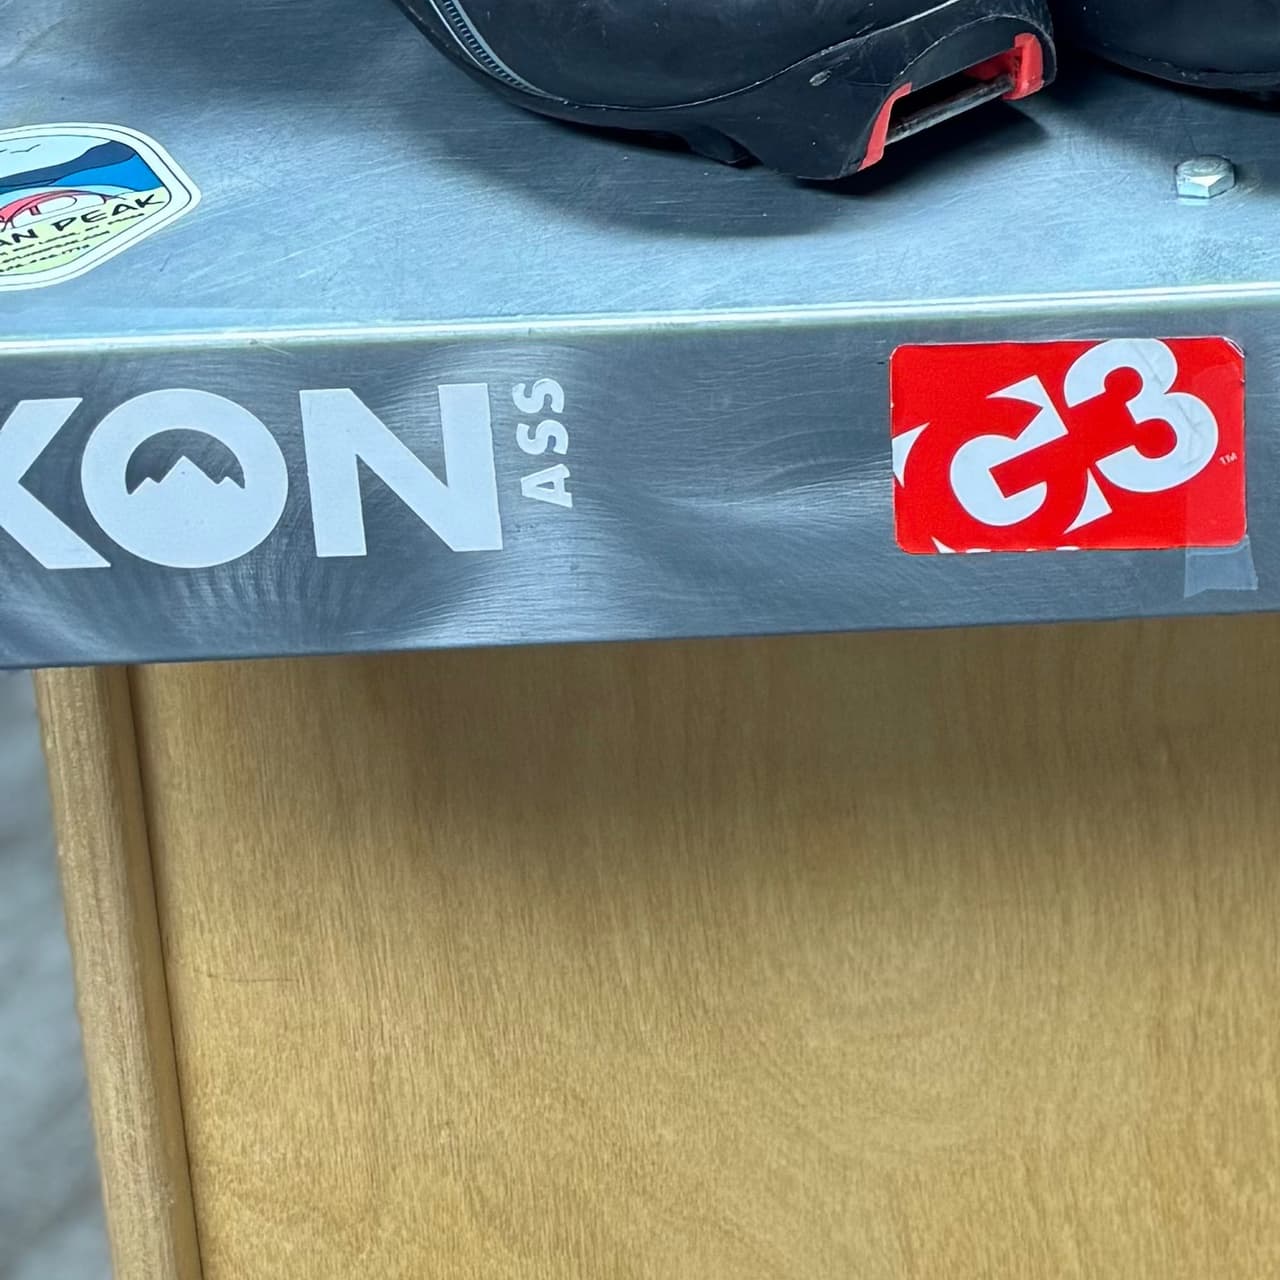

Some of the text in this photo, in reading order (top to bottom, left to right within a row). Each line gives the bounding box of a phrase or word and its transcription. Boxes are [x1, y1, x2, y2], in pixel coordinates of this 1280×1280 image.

[51, 192, 166, 232] PEAK
[512, 378, 573, 508] ASS
[950, 338, 1219, 534] G3
